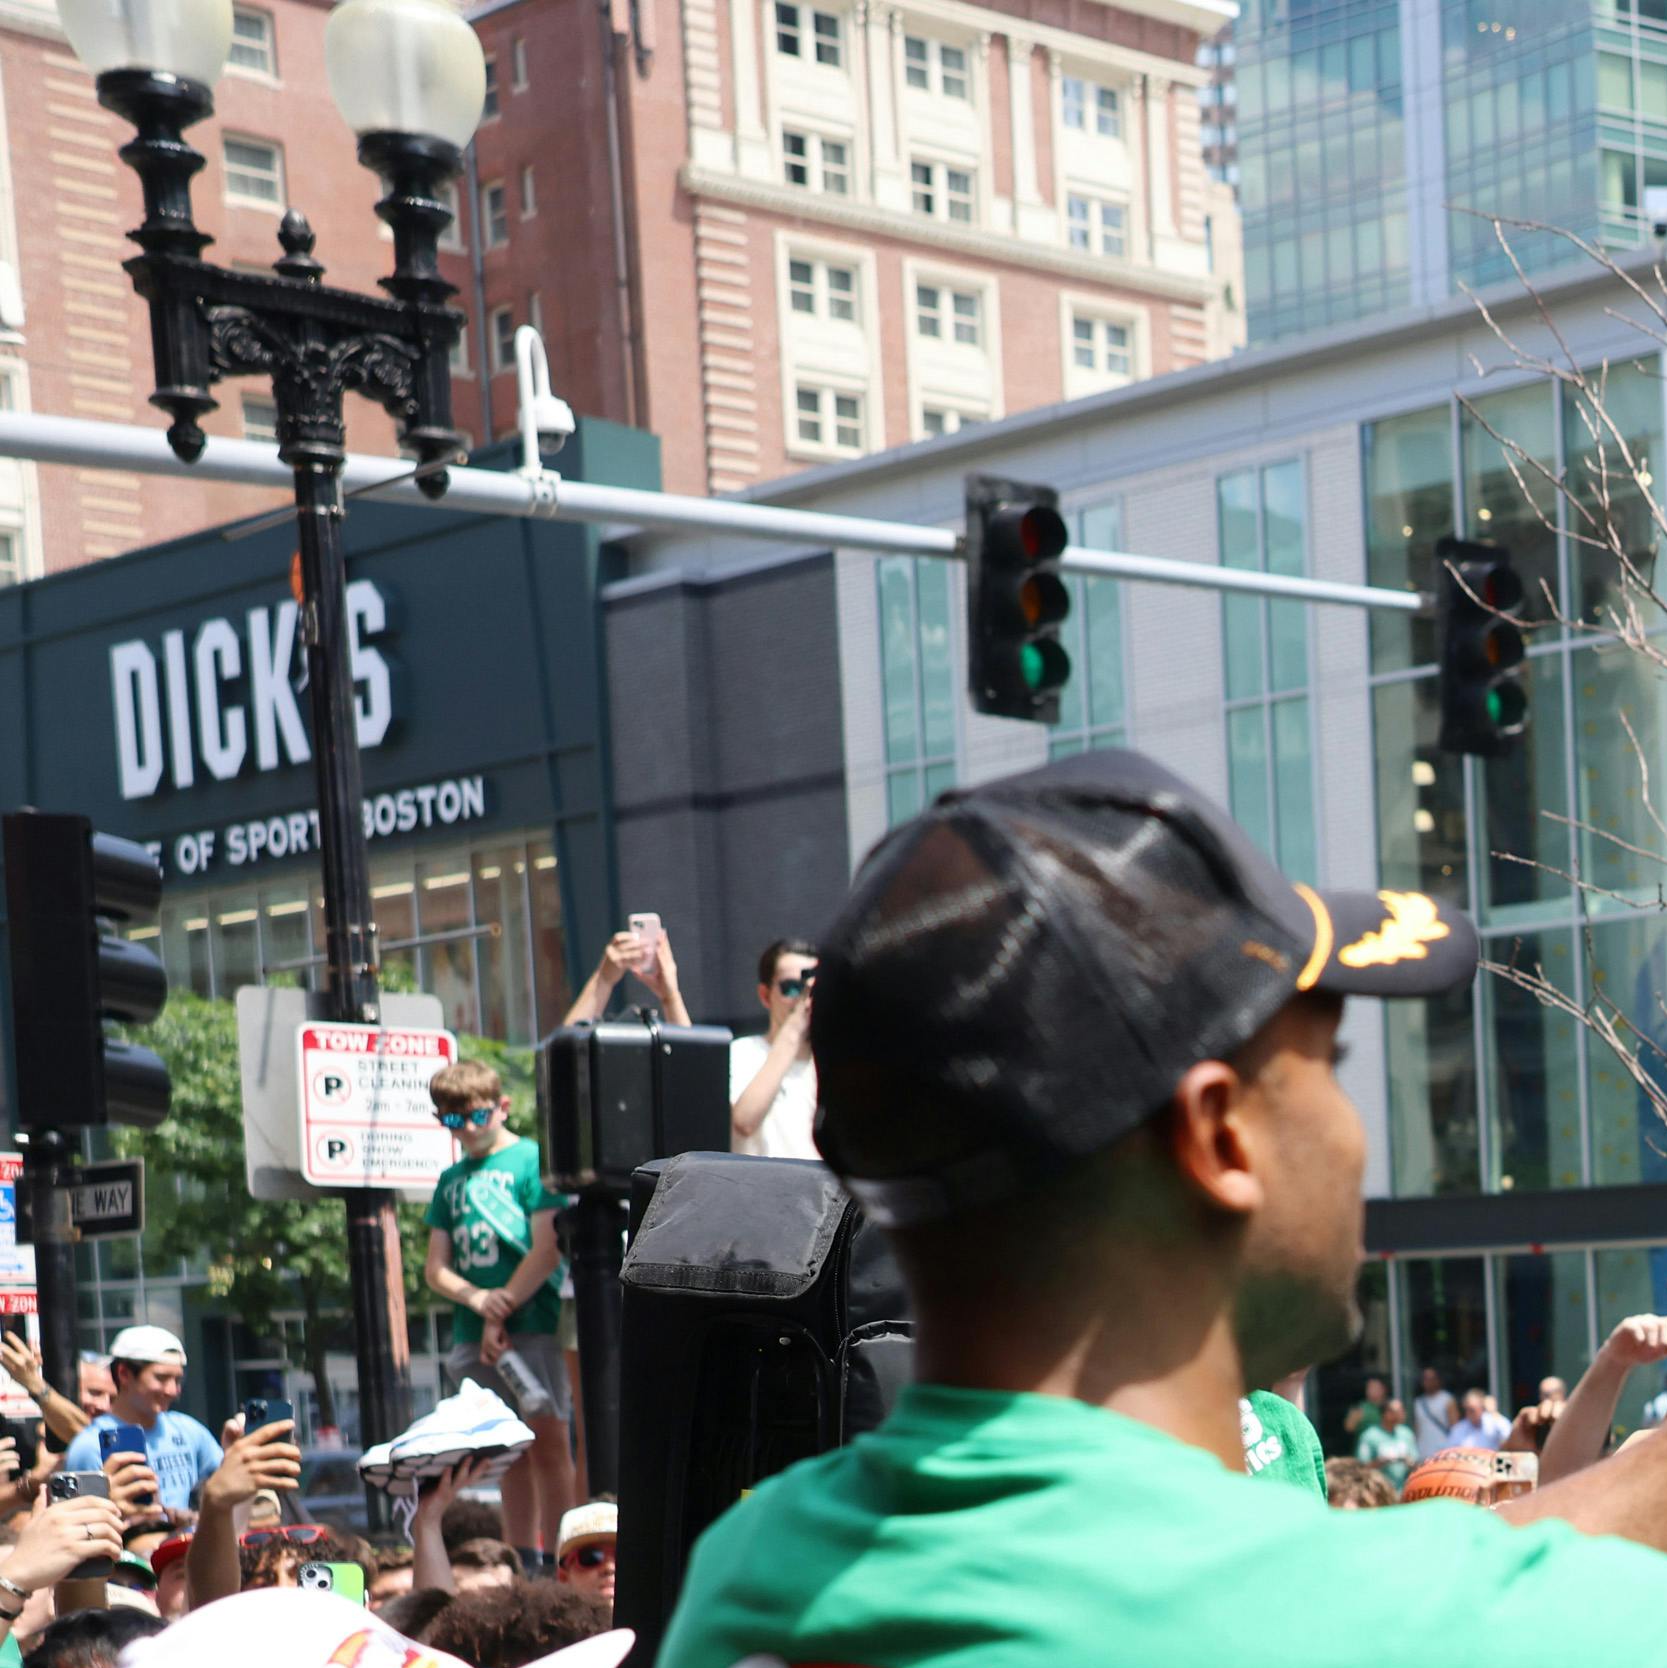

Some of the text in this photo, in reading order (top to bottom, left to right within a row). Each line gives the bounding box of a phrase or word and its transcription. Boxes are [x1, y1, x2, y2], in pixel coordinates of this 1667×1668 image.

[176, 831, 216, 875] OF
[225, 808, 321, 867] SPORT
[361, 776, 485, 841] BOSTON
[315, 1031, 369, 1052] TOW
[357, 1060, 420, 1074] STREET
[358, 1078, 430, 1092] CLEANIN
[94, 1187, 128, 1214] WAY
[11, 1295, 37, 1313] ZON
